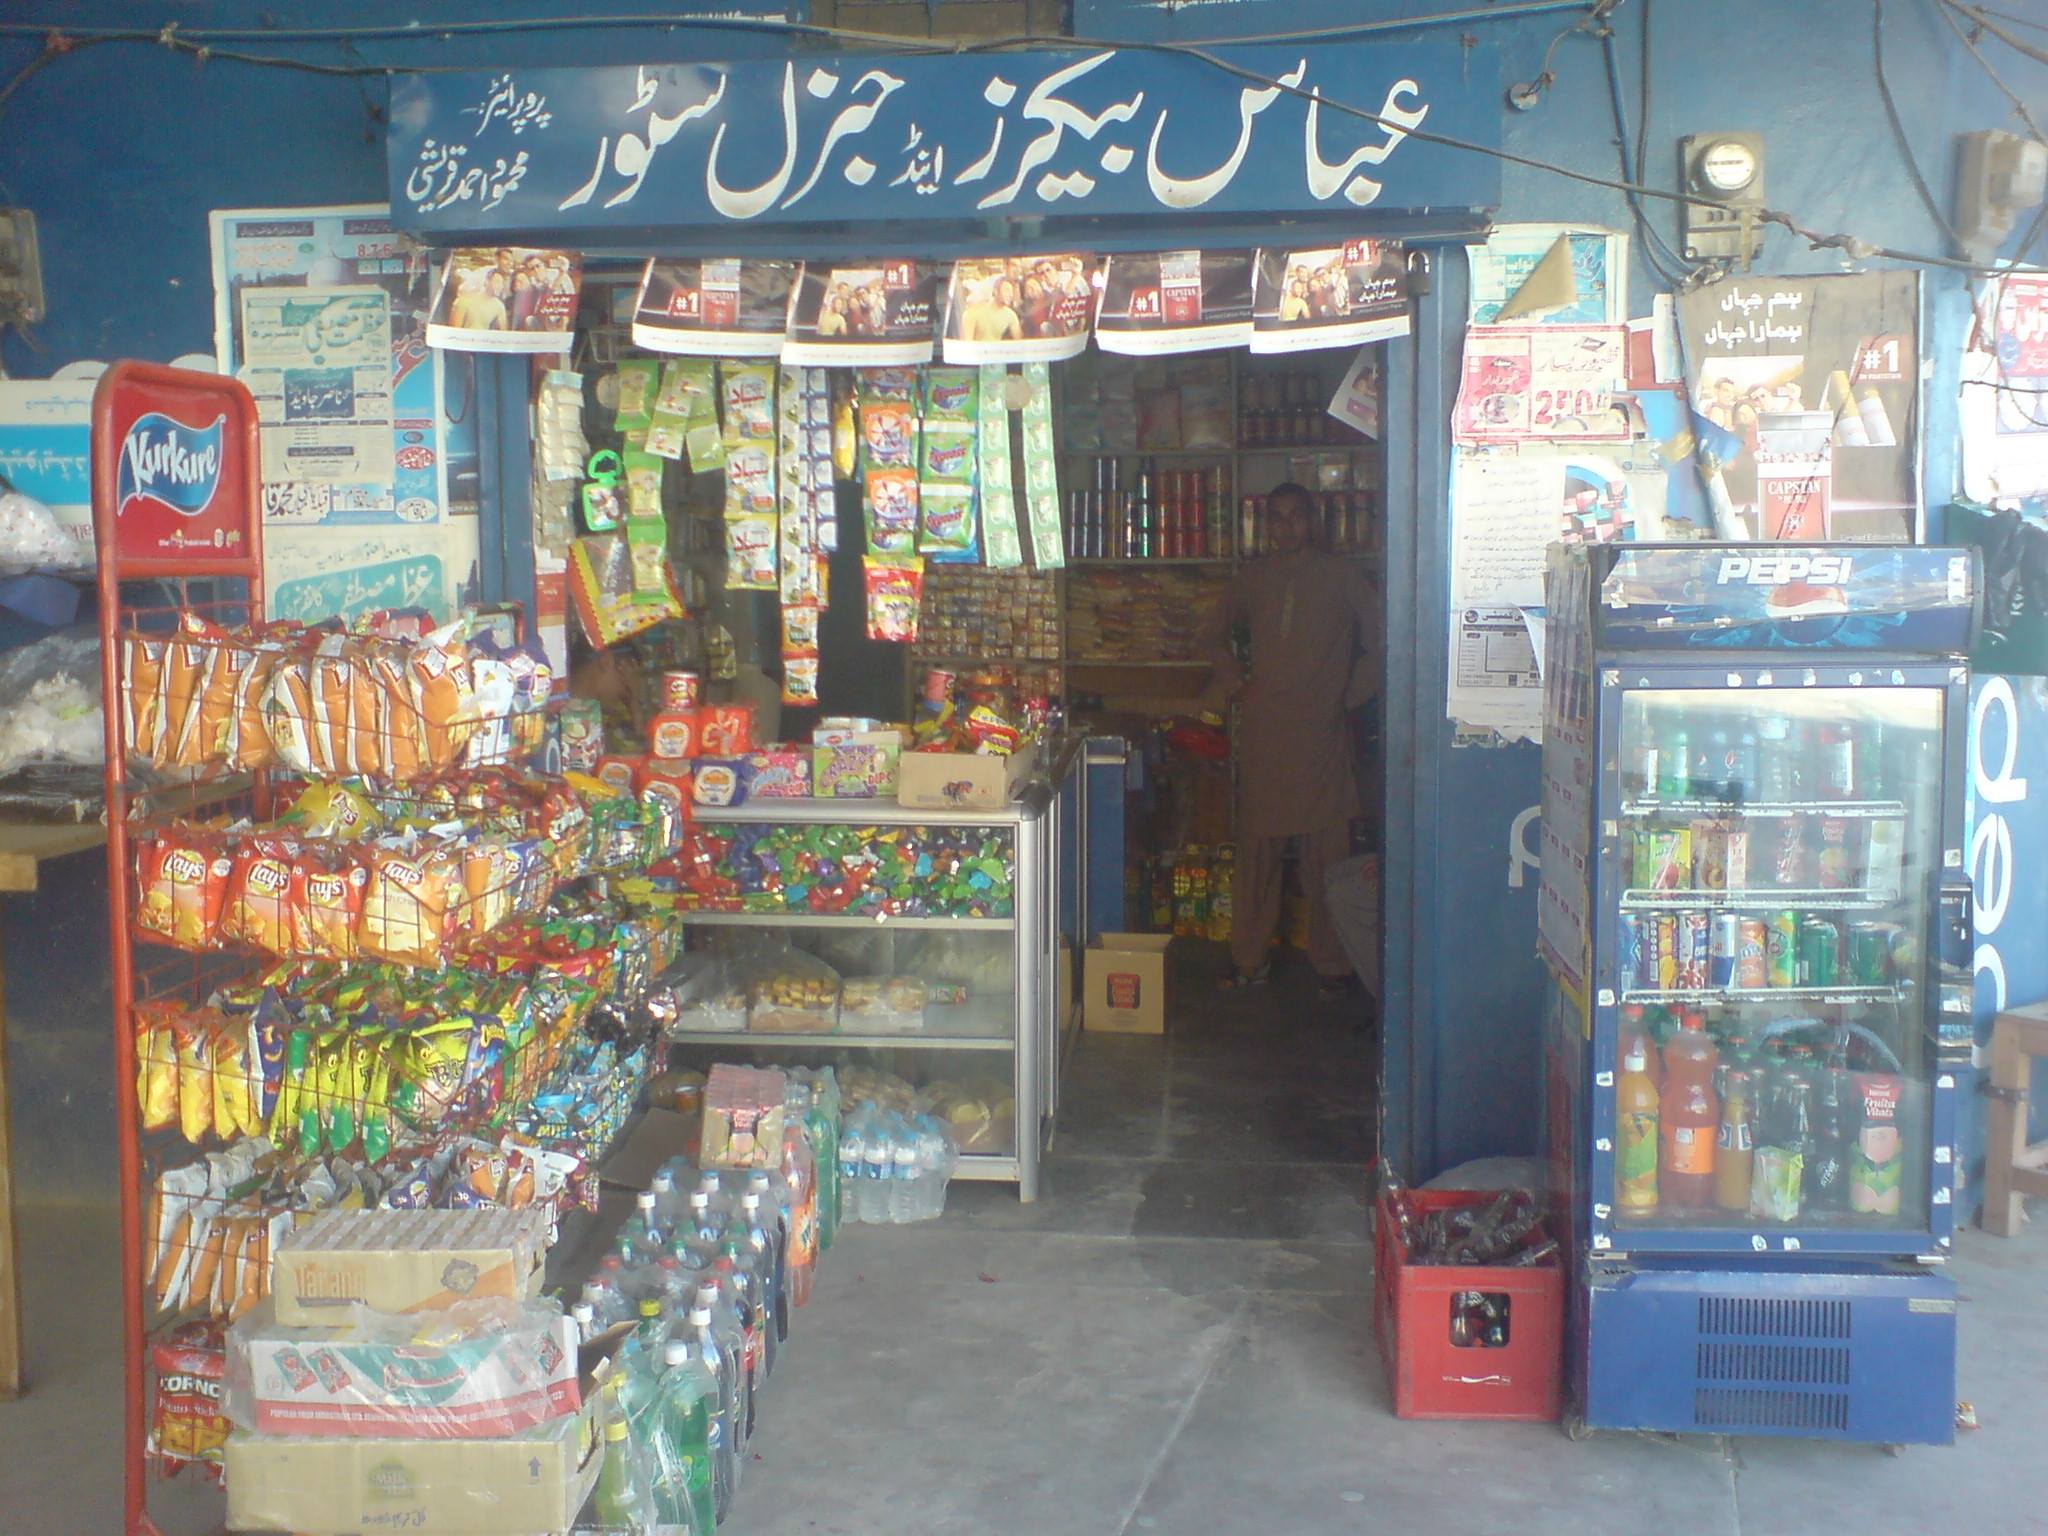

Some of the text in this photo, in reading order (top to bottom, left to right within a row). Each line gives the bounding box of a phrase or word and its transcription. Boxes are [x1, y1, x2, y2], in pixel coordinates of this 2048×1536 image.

[558, 66, 727, 211] سٹور
[707, 61, 906, 219] جنرل
[1147, 58, 1429, 208] عباس
[1347, 240, 1370, 261] #1
[887, 265, 909, 284] #1
[676, 292, 698, 312] #1
[1136, 292, 1158, 313] #1
[1721, 287, 1802, 317] ہم جہاں
[1705, 320, 1802, 349] ہمارا جہاں
[1863, 340, 1900, 372] #1
[127, 430, 216, 500] Kurkure
[1768, 479, 1821, 495] CAPSTAN
[1717, 557, 1854, 585] PEPSI
